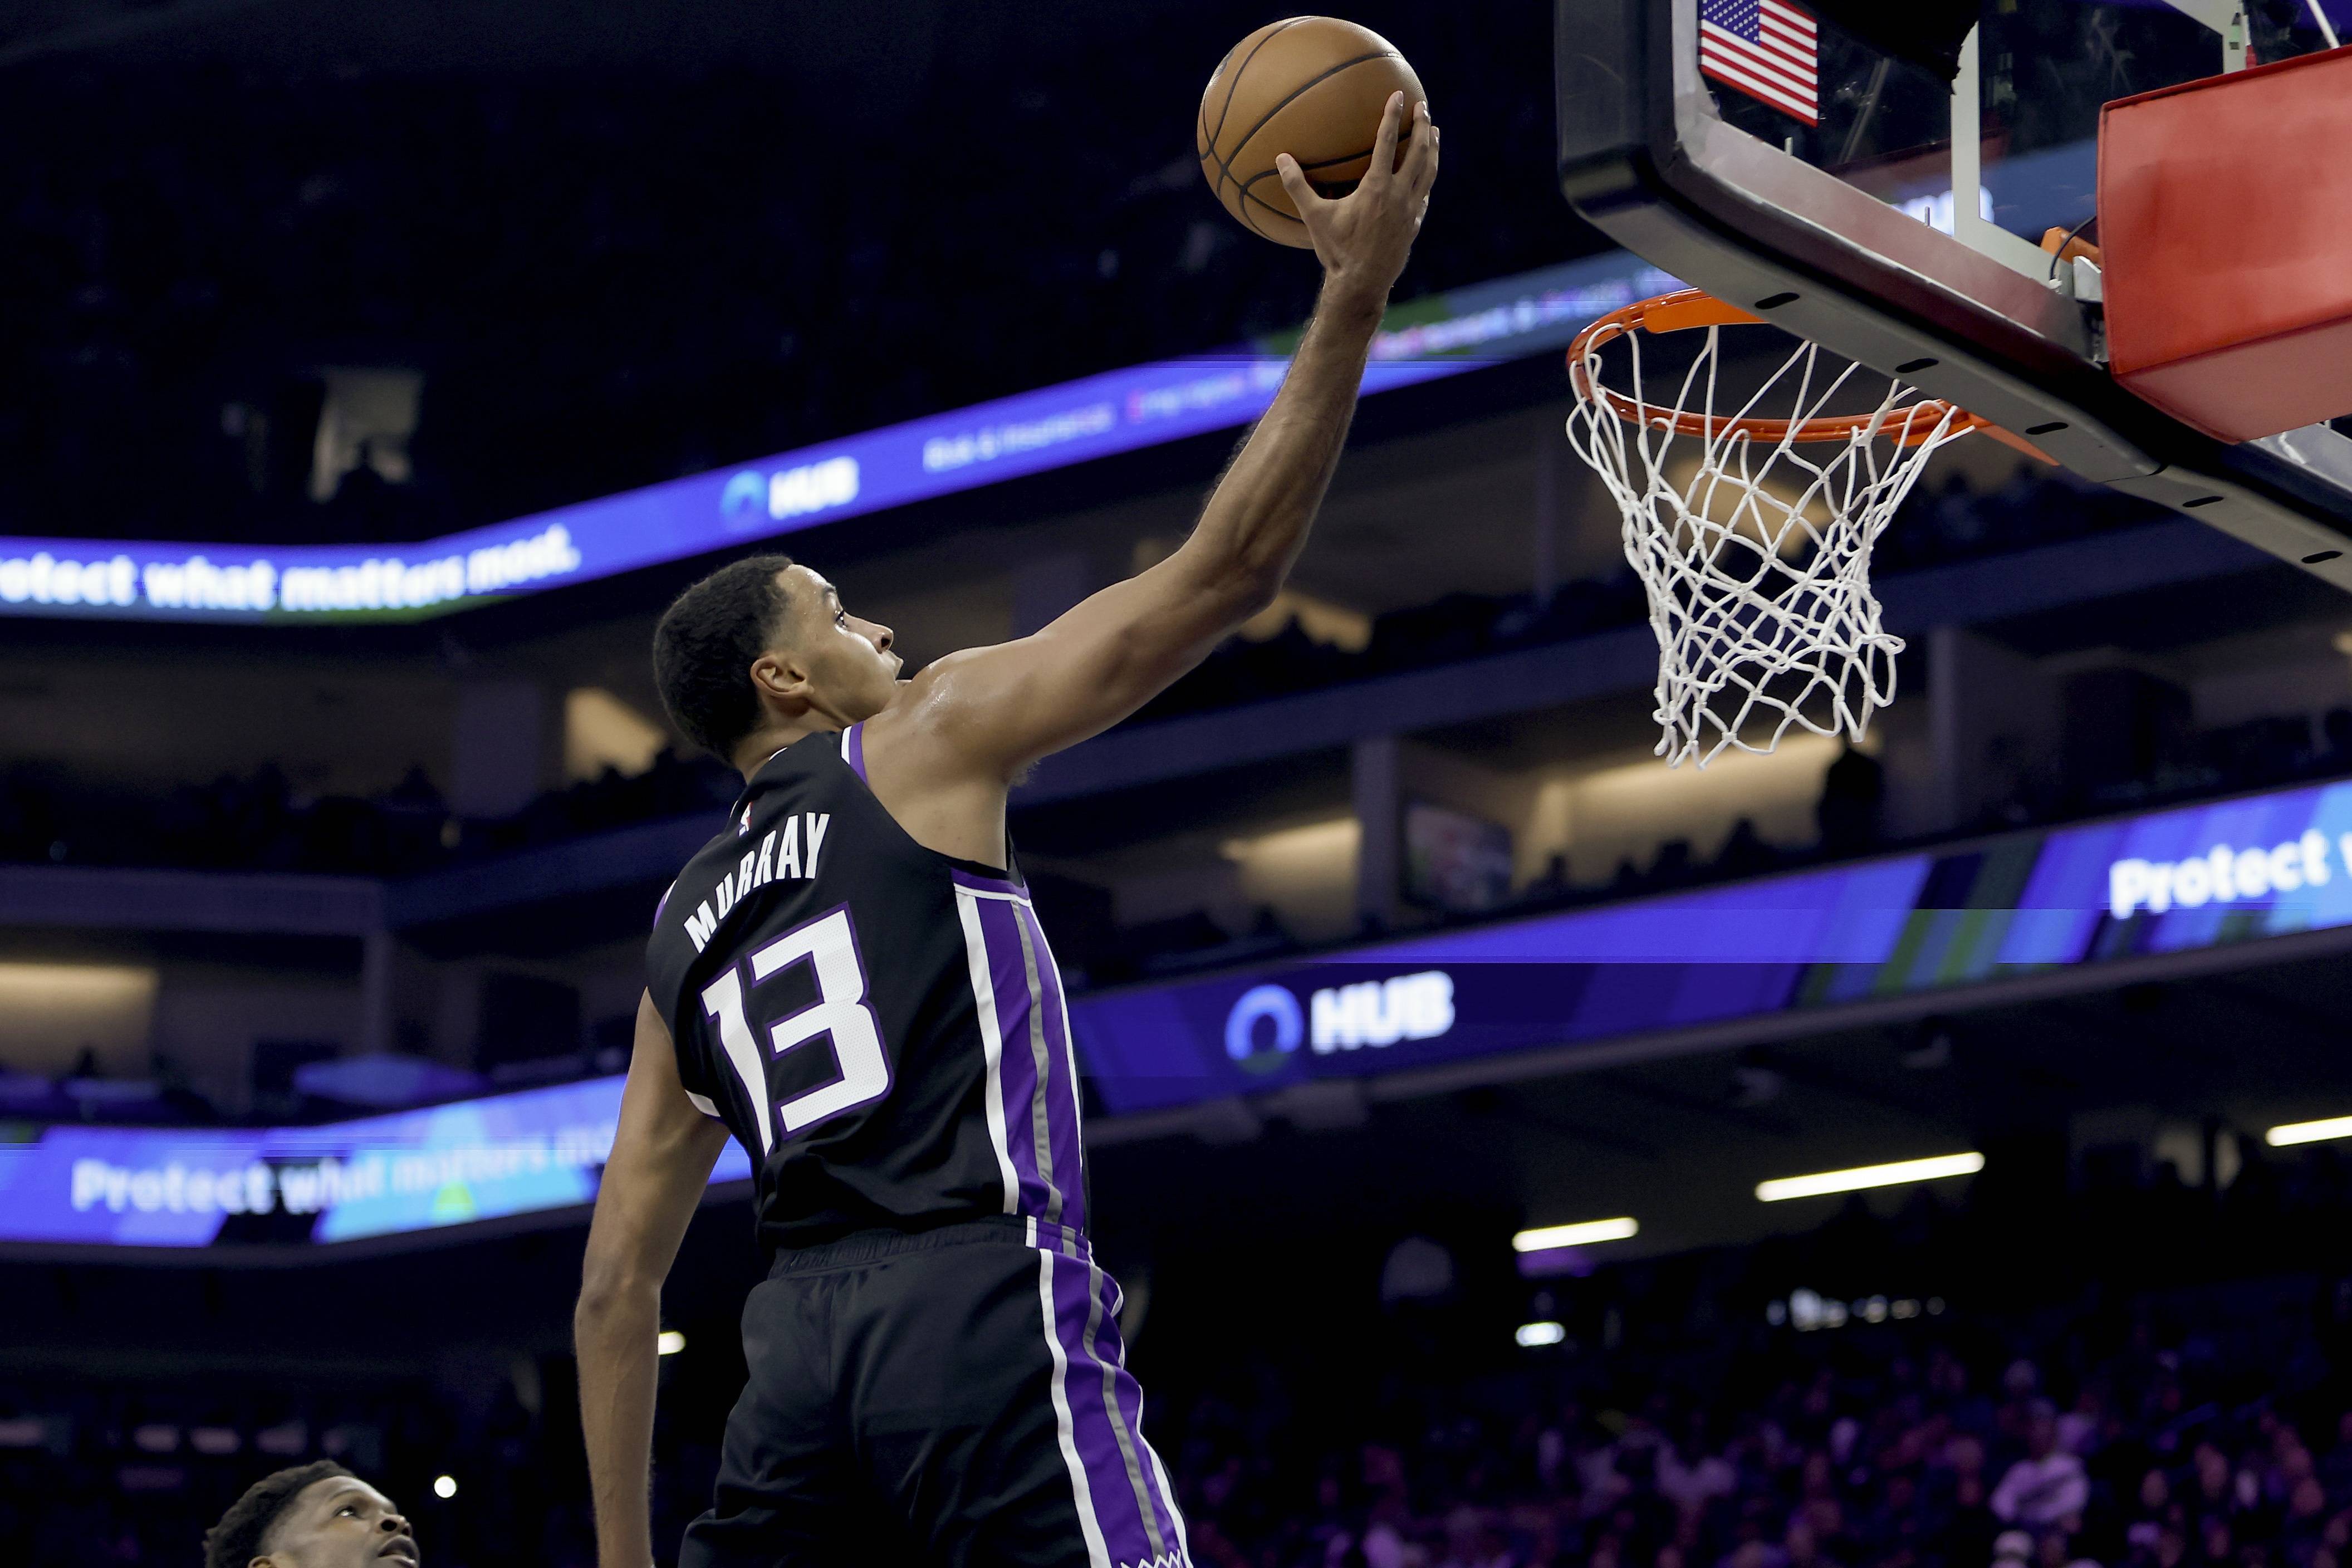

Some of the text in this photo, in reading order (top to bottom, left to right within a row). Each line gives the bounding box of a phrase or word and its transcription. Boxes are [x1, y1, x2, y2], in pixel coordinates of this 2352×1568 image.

[768, 456, 859, 520] HUB
[143, 556, 278, 611] what
[683, 812, 830, 954] MURRAY
[2109, 829, 2330, 919] Protect
[697, 901, 894, 1157] 13
[1311, 970, 1456, 1055] HUB
[71, 1157, 275, 1214] Protect
[280, 1156, 385, 1214] what
